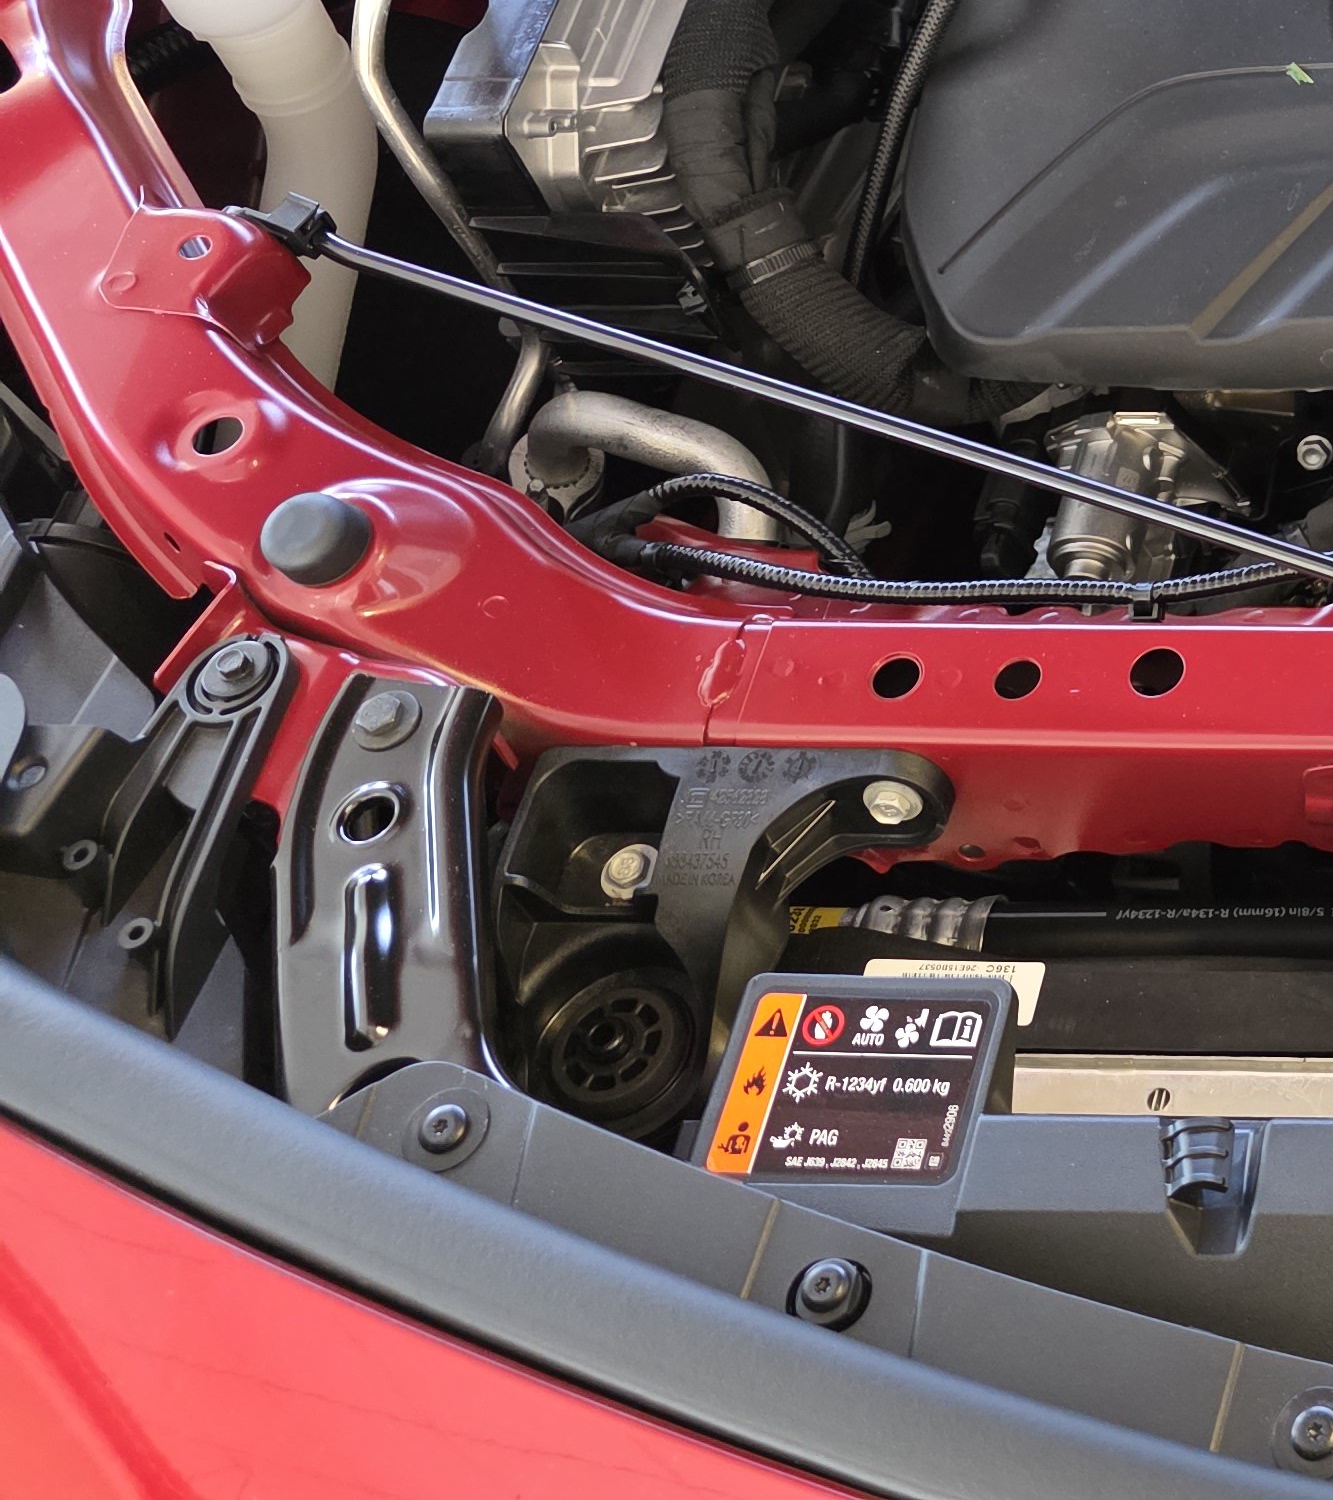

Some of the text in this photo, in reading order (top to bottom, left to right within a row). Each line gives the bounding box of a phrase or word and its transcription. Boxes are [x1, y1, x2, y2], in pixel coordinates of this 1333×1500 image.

[702, 829, 722, 849] RH
[701, 873, 736, 886] KOREA
[1115, 907, 1230, 920] R-134a/R-1234yf
[1233, 906, 1287, 918] (16mm)
[851, 1033, 885, 1046] AUTO
[824, 1076, 951, 1097] R-1234yf 0.600 kg
[809, 1128, 839, 1146] PAG
[784, 1156, 803, 1168] SAE
